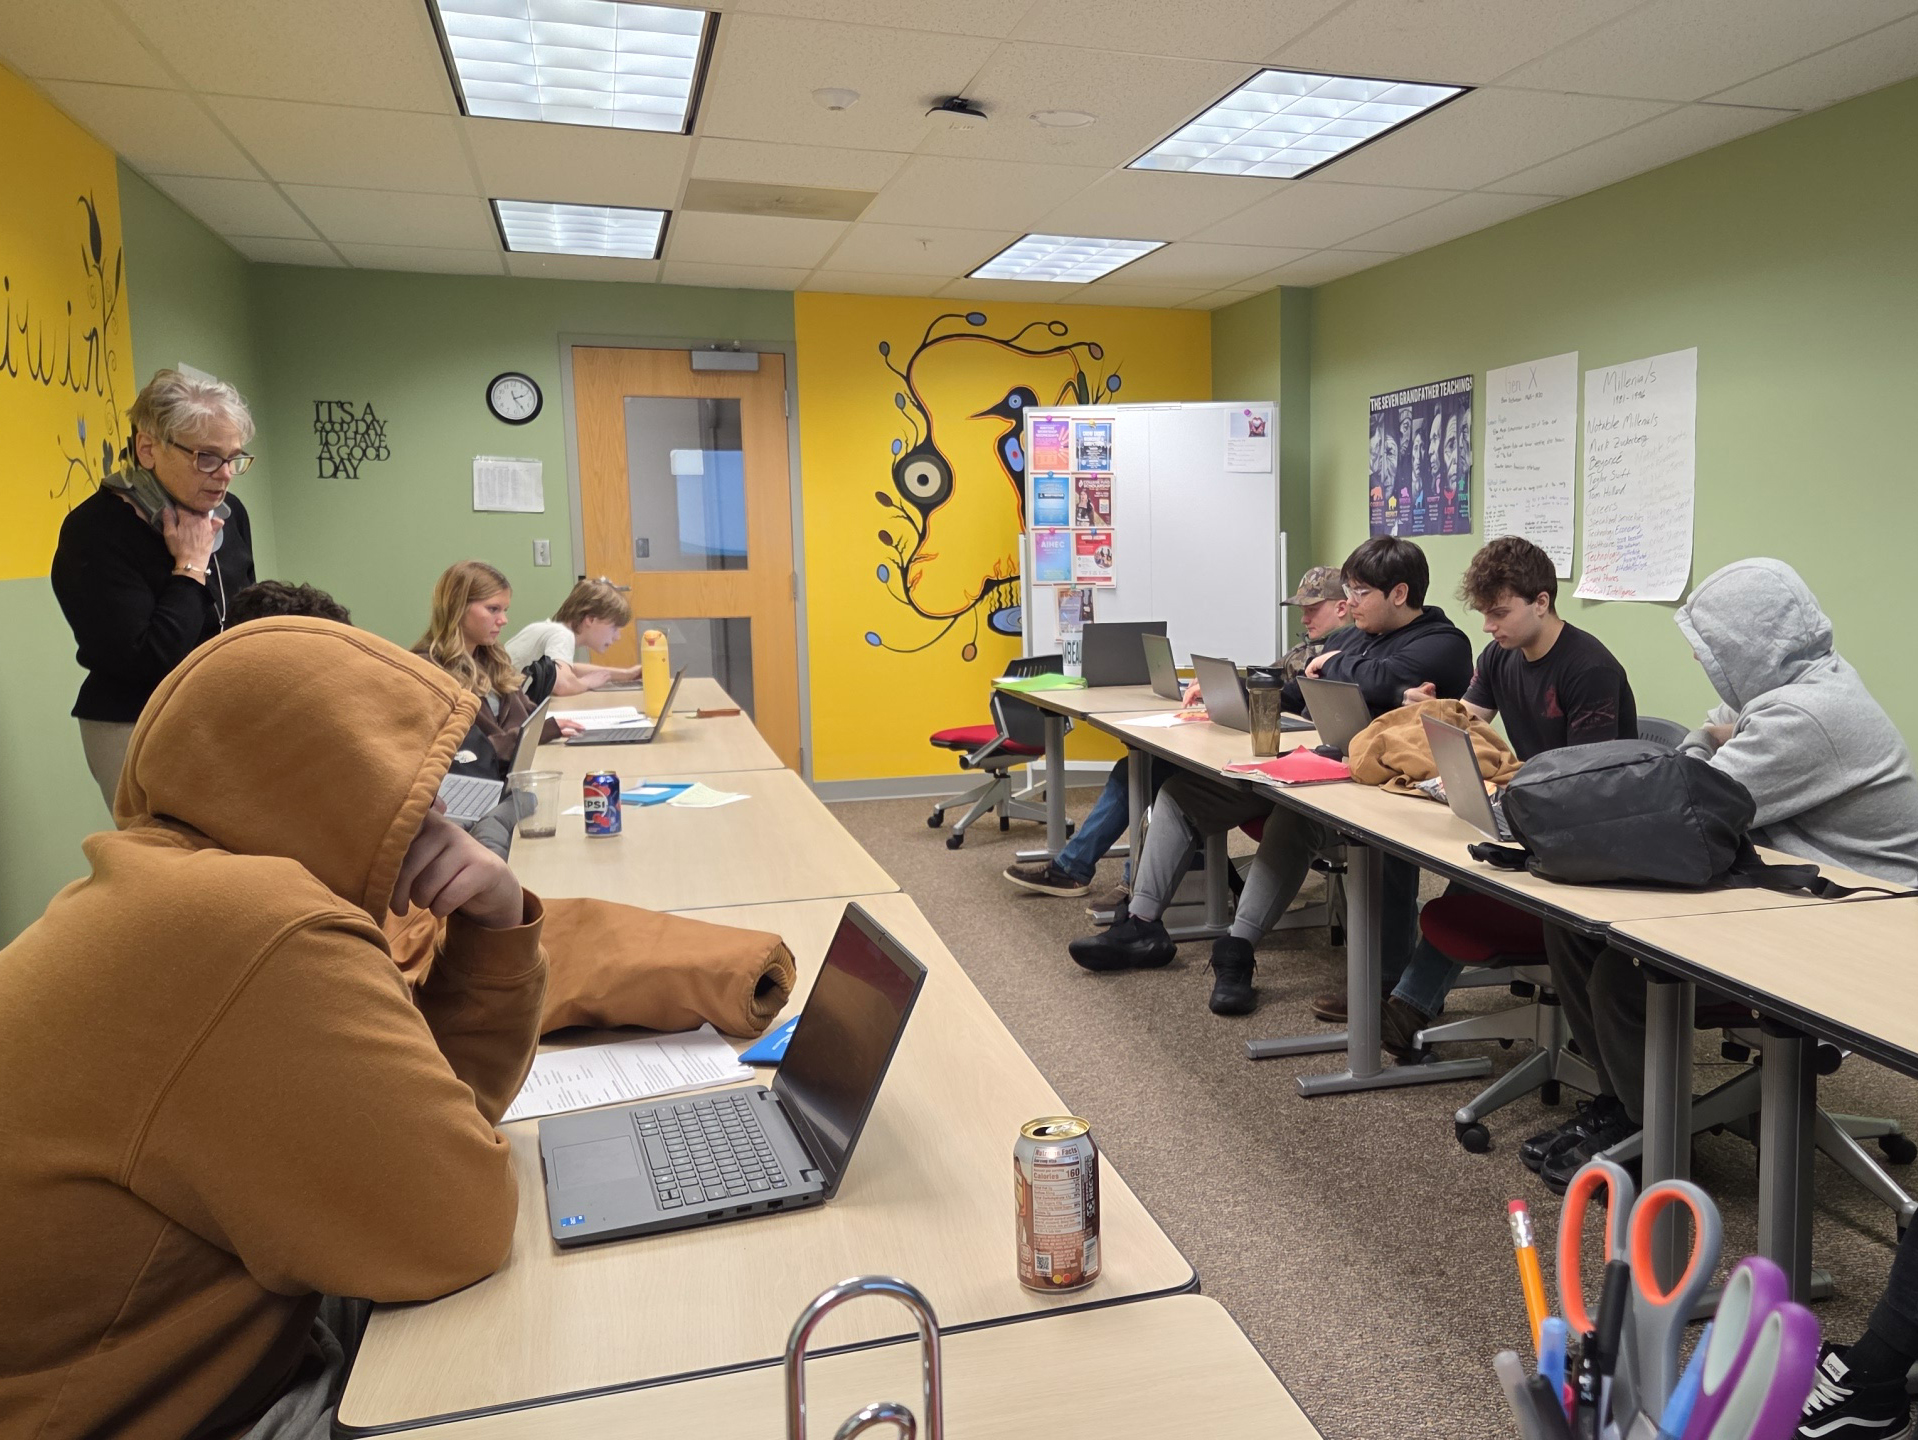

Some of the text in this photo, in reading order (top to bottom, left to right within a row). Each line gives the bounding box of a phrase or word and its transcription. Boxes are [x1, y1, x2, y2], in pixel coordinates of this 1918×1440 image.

[1528, 366, 1538, 390] X
[1370, 377, 1473, 411] THE SEVEN GRANDFATHER TEACHINGS
[361, 402, 376, 421] A
[314, 419, 388, 435] GOOD DAY
[1587, 415, 1619, 434] Notable
[314, 430, 387, 447] TO HAVE
[316, 442, 390, 461] A GOOD
[317, 458, 361, 479] DAY
[584, 800, 605, 809] EPSI
[1061, 1147, 1078, 1156] Facts
[1066, 1168, 1080, 1178] 160
